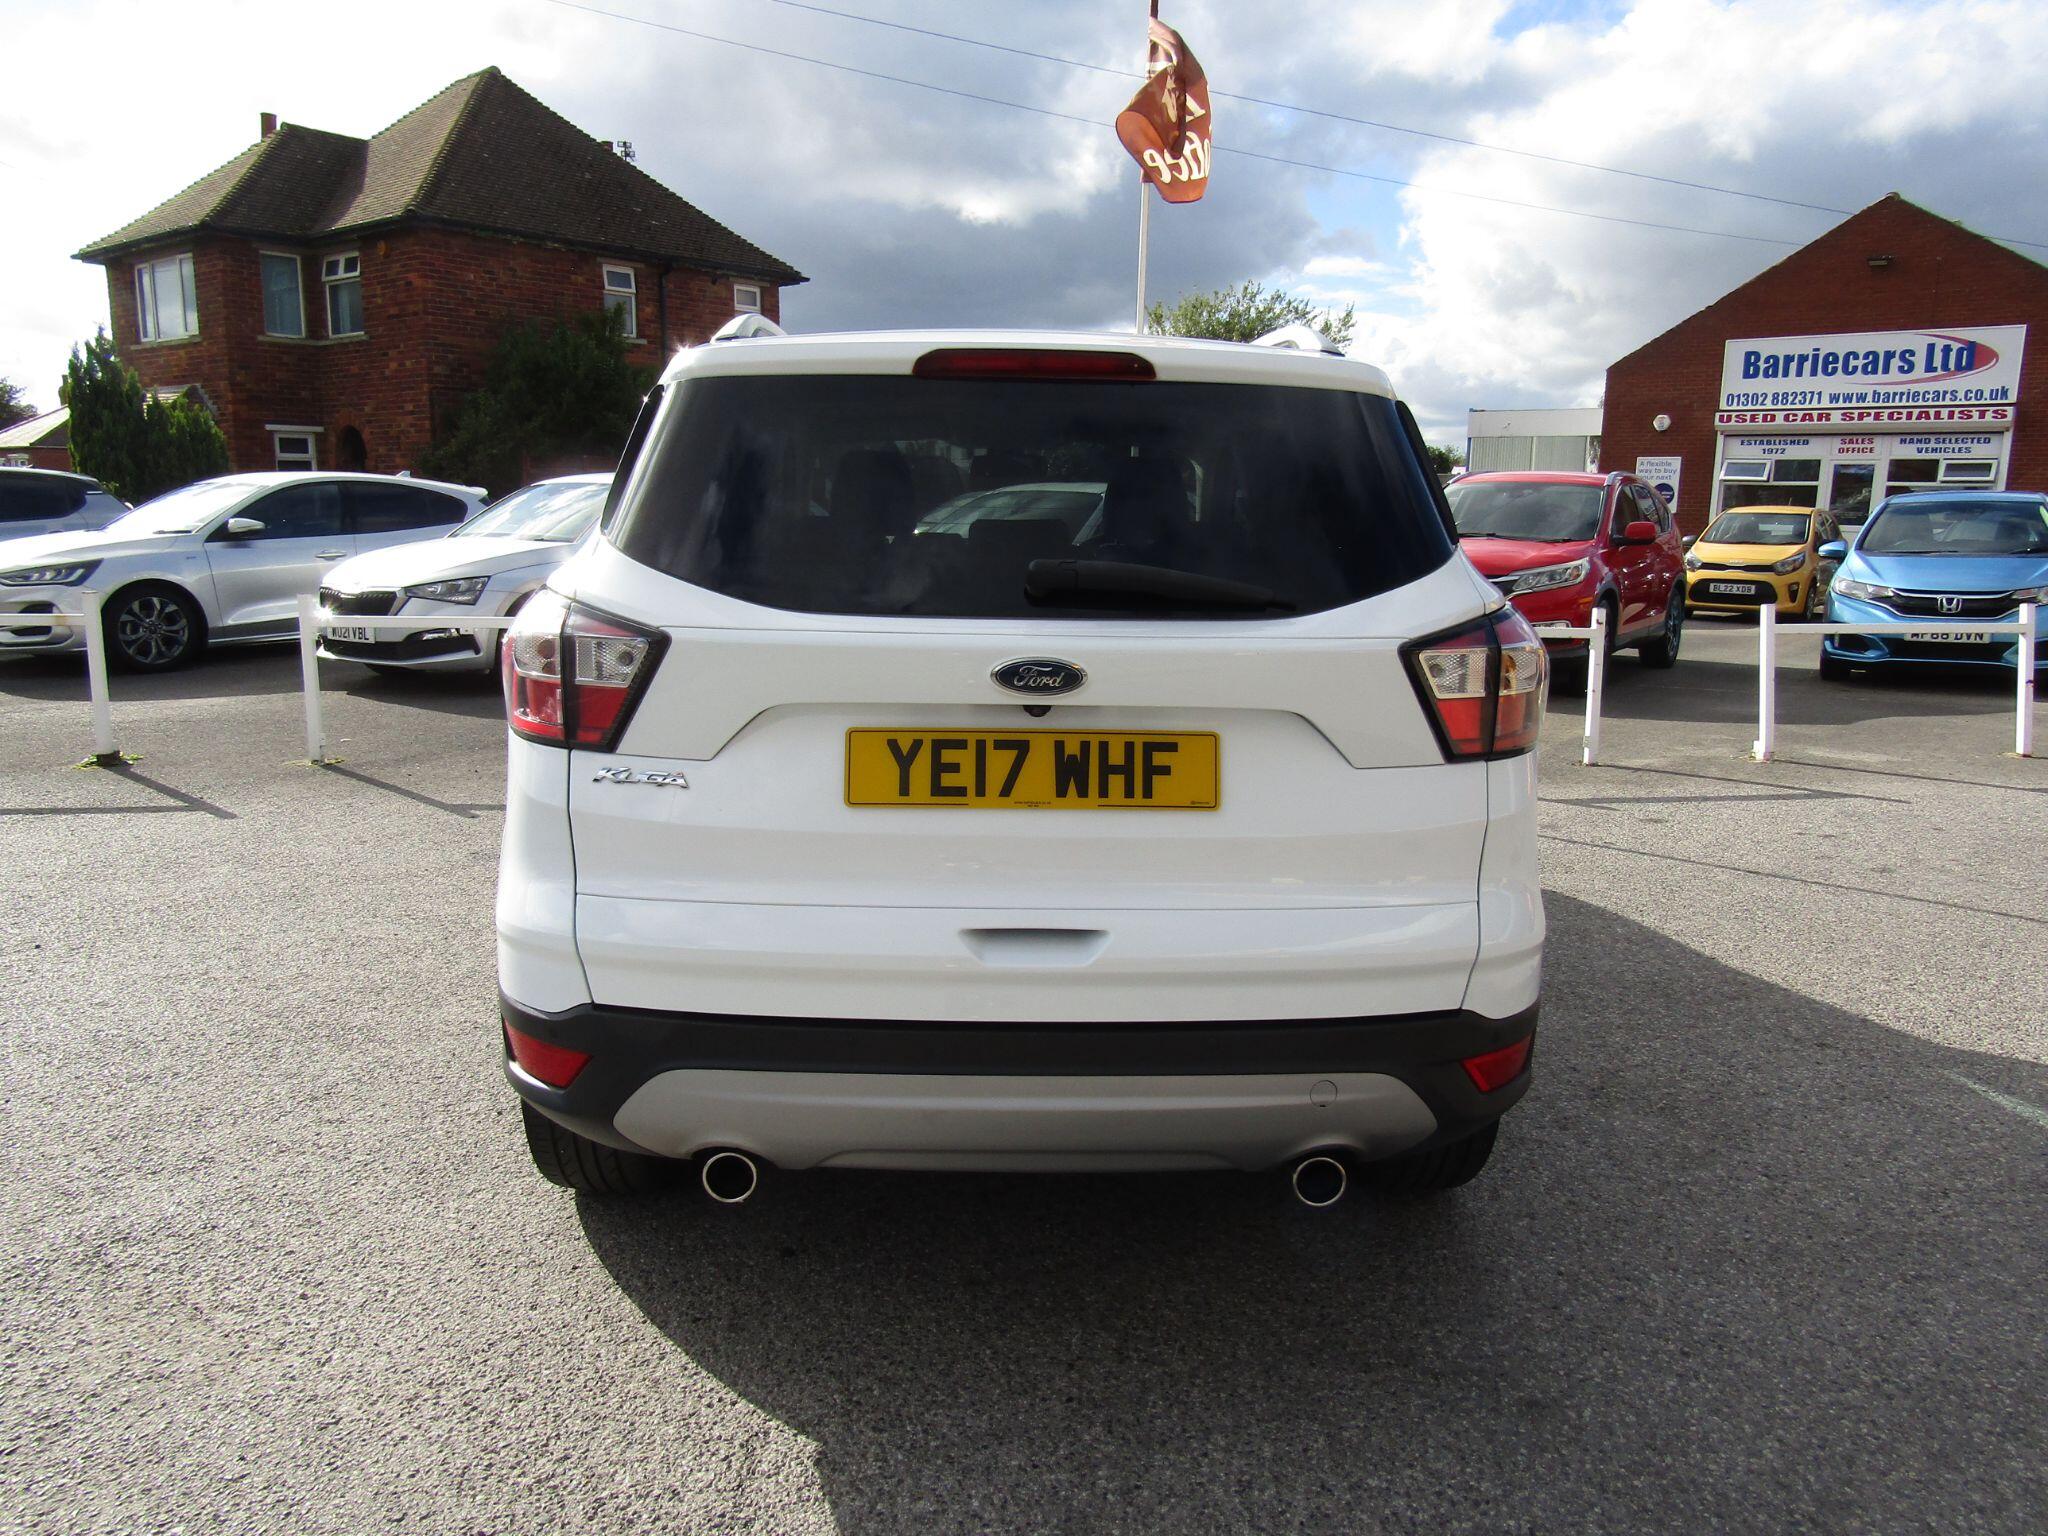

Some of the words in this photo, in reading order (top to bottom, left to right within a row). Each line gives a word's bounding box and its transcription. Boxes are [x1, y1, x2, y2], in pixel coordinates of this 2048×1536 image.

[1742, 346, 1916, 380] Barriecars
[1924, 340, 1977, 373] Ltd
[1726, 392, 1768, 407] 01302
[1770, 390, 1822, 406] 882371
[1828, 385, 2010, 405] www.barriecars.co.uk
[1718, 413, 1776, 424] USED
[1783, 412, 1831, 423] CAR
[1840, 408, 2009, 422] SPECIALISTS
[1740, 438, 1810, 446] ESTABLISHED
[1839, 437, 1874, 445] SALES
[1899, 437, 1931, 445] HAND
[1934, 436, 1991, 445] SELECTED
[1762, 447, 1786, 455] 1972
[1837, 446, 1875, 454] OFFICE
[1916, 446, 1972, 454] VEHICLES
[1663, 467, 1678, 475] buy
[351, 626, 370, 641] VBL
[1013, 665, 1065, 688] Ford
[886, 738, 1031, 798] YE17
[1053, 739, 1179, 799] WHF
